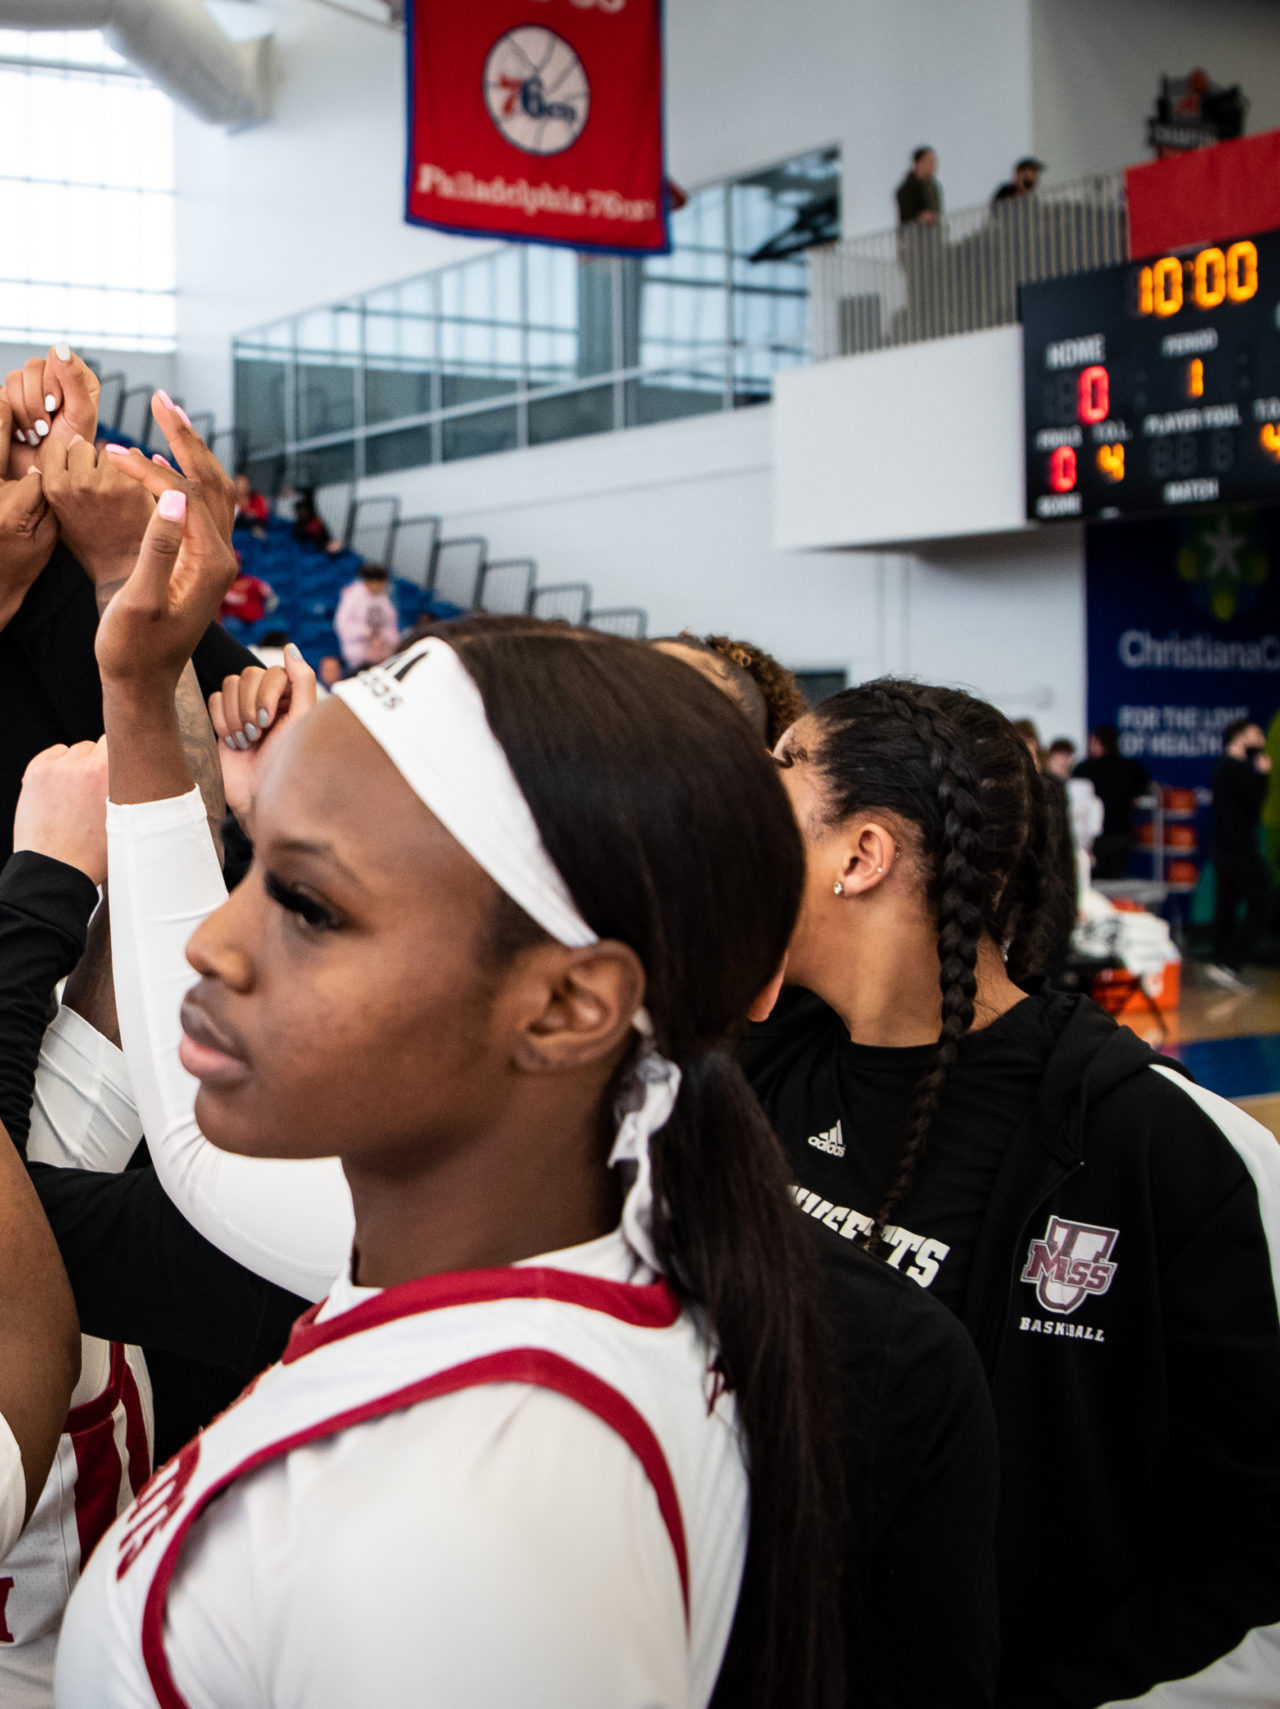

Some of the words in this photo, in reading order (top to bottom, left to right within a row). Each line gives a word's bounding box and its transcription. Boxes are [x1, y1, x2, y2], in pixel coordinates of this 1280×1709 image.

[1045, 333, 1106, 370] HOME
[1078, 365, 1110, 424] 0
[1049, 445, 1077, 493] 0
[1096, 442, 1125, 482] 4
[807, 1135, 846, 1158] adidas
[1020, 1239, 1118, 1294] MSS
